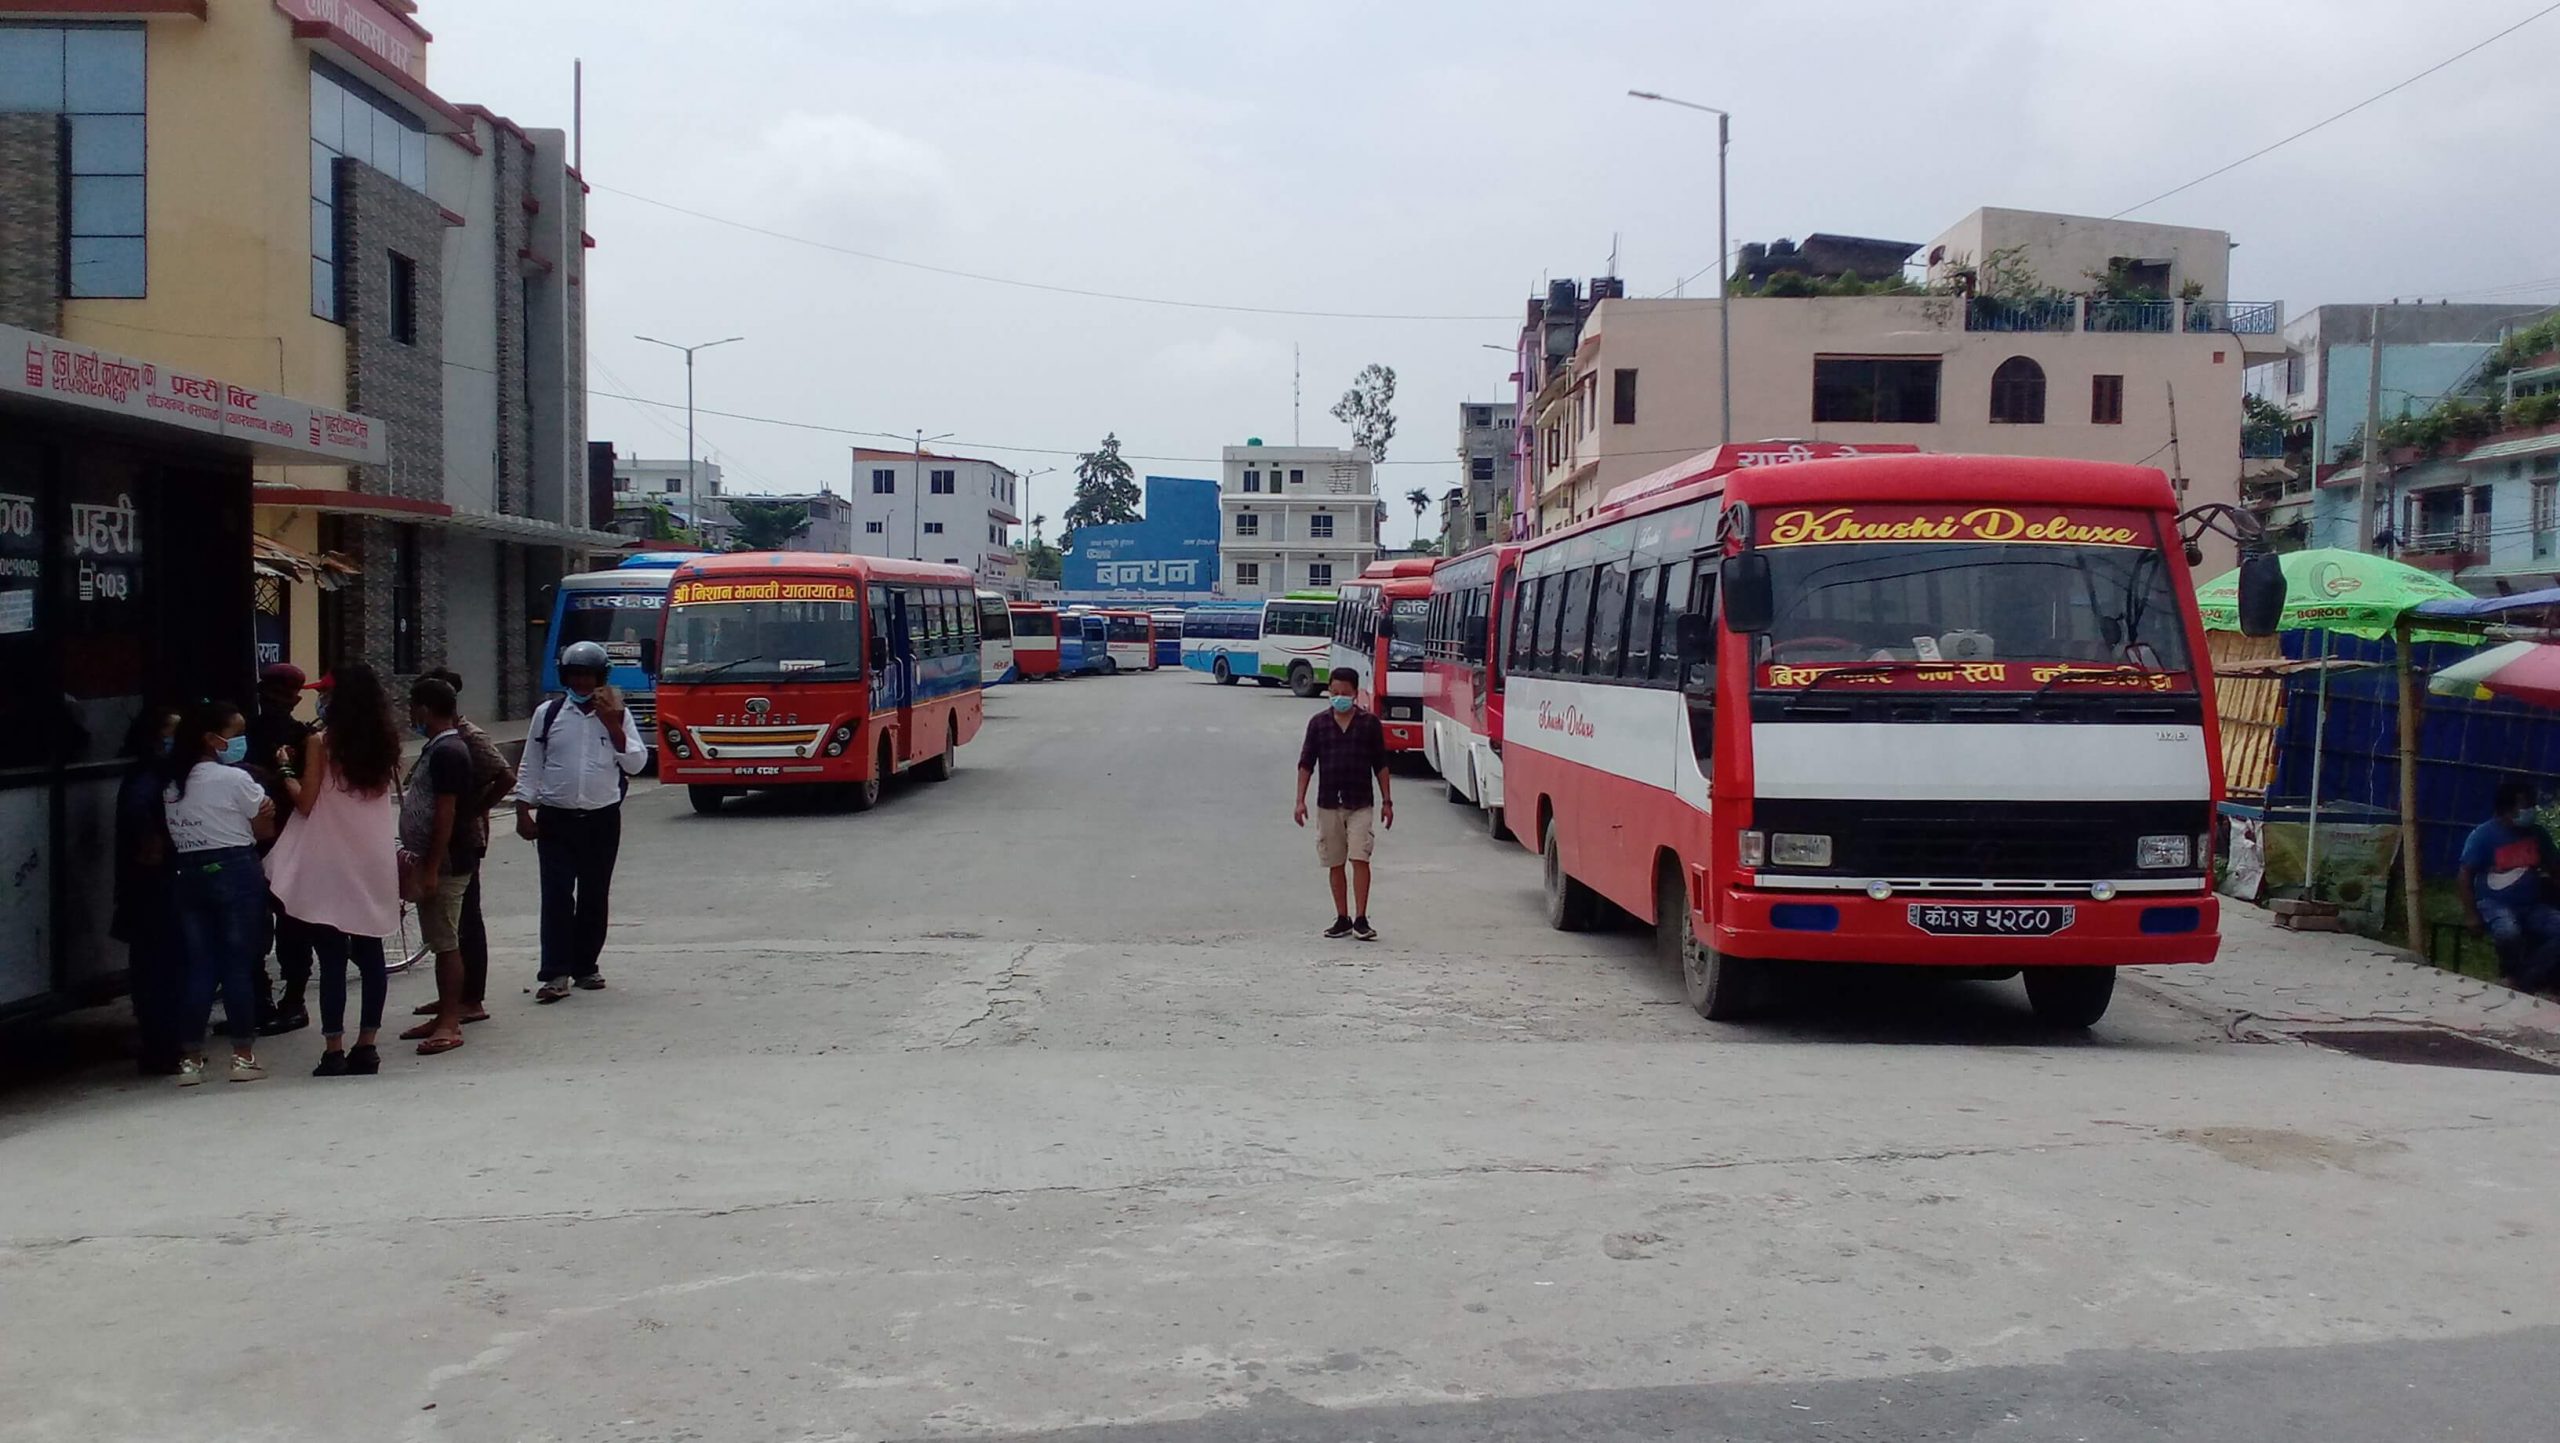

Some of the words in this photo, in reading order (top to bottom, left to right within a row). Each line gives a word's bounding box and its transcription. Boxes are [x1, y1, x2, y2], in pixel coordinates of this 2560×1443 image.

[52, 350, 69, 376] वडा
[74, 352, 98, 382] प्रहरी
[171, 375, 218, 402] प्रहरी
[228, 385, 258, 410] बिट
[71, 493, 136, 555] प्रहरी
[1770, 508, 1958, 543] Khushi
[1961, 508, 2139, 543] Deluxe
[96, 573, 127, 600] १०३
[1097, 560, 1199, 586] बन्धन
[673, 583, 689, 603] श्री
[691, 582, 733, 601] निशान
[735, 580, 779, 600] भगवती
[782, 583, 838, 600] यातायात
[2297, 606, 2349, 619] BEDROCK
[1985, 909, 2051, 932] ५२८०
